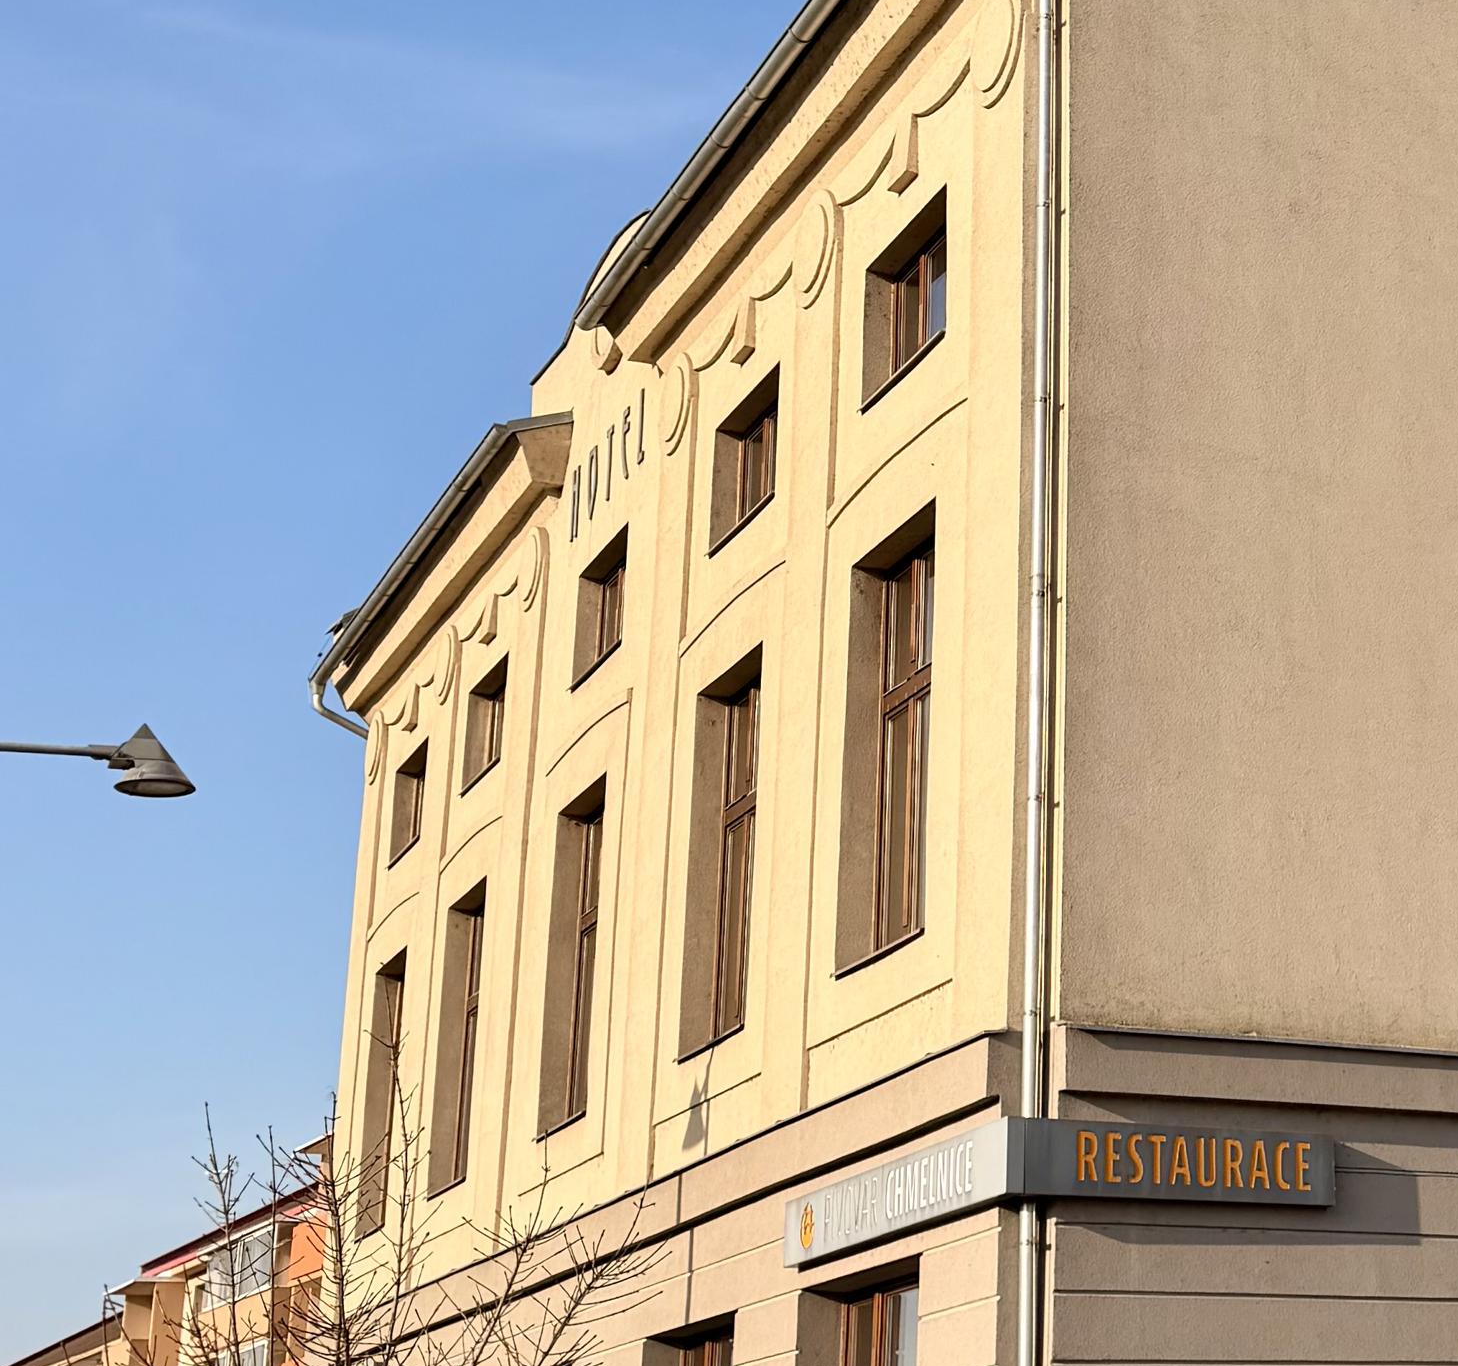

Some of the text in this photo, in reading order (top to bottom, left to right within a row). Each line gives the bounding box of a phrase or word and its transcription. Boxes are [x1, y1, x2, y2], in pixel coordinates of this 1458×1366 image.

[569, 388, 646, 544] HOTEL
[823, 1140, 975, 1244] PIVOVAR CHMELNICE
[1076, 1129, 1312, 1192] RESTAURACE
